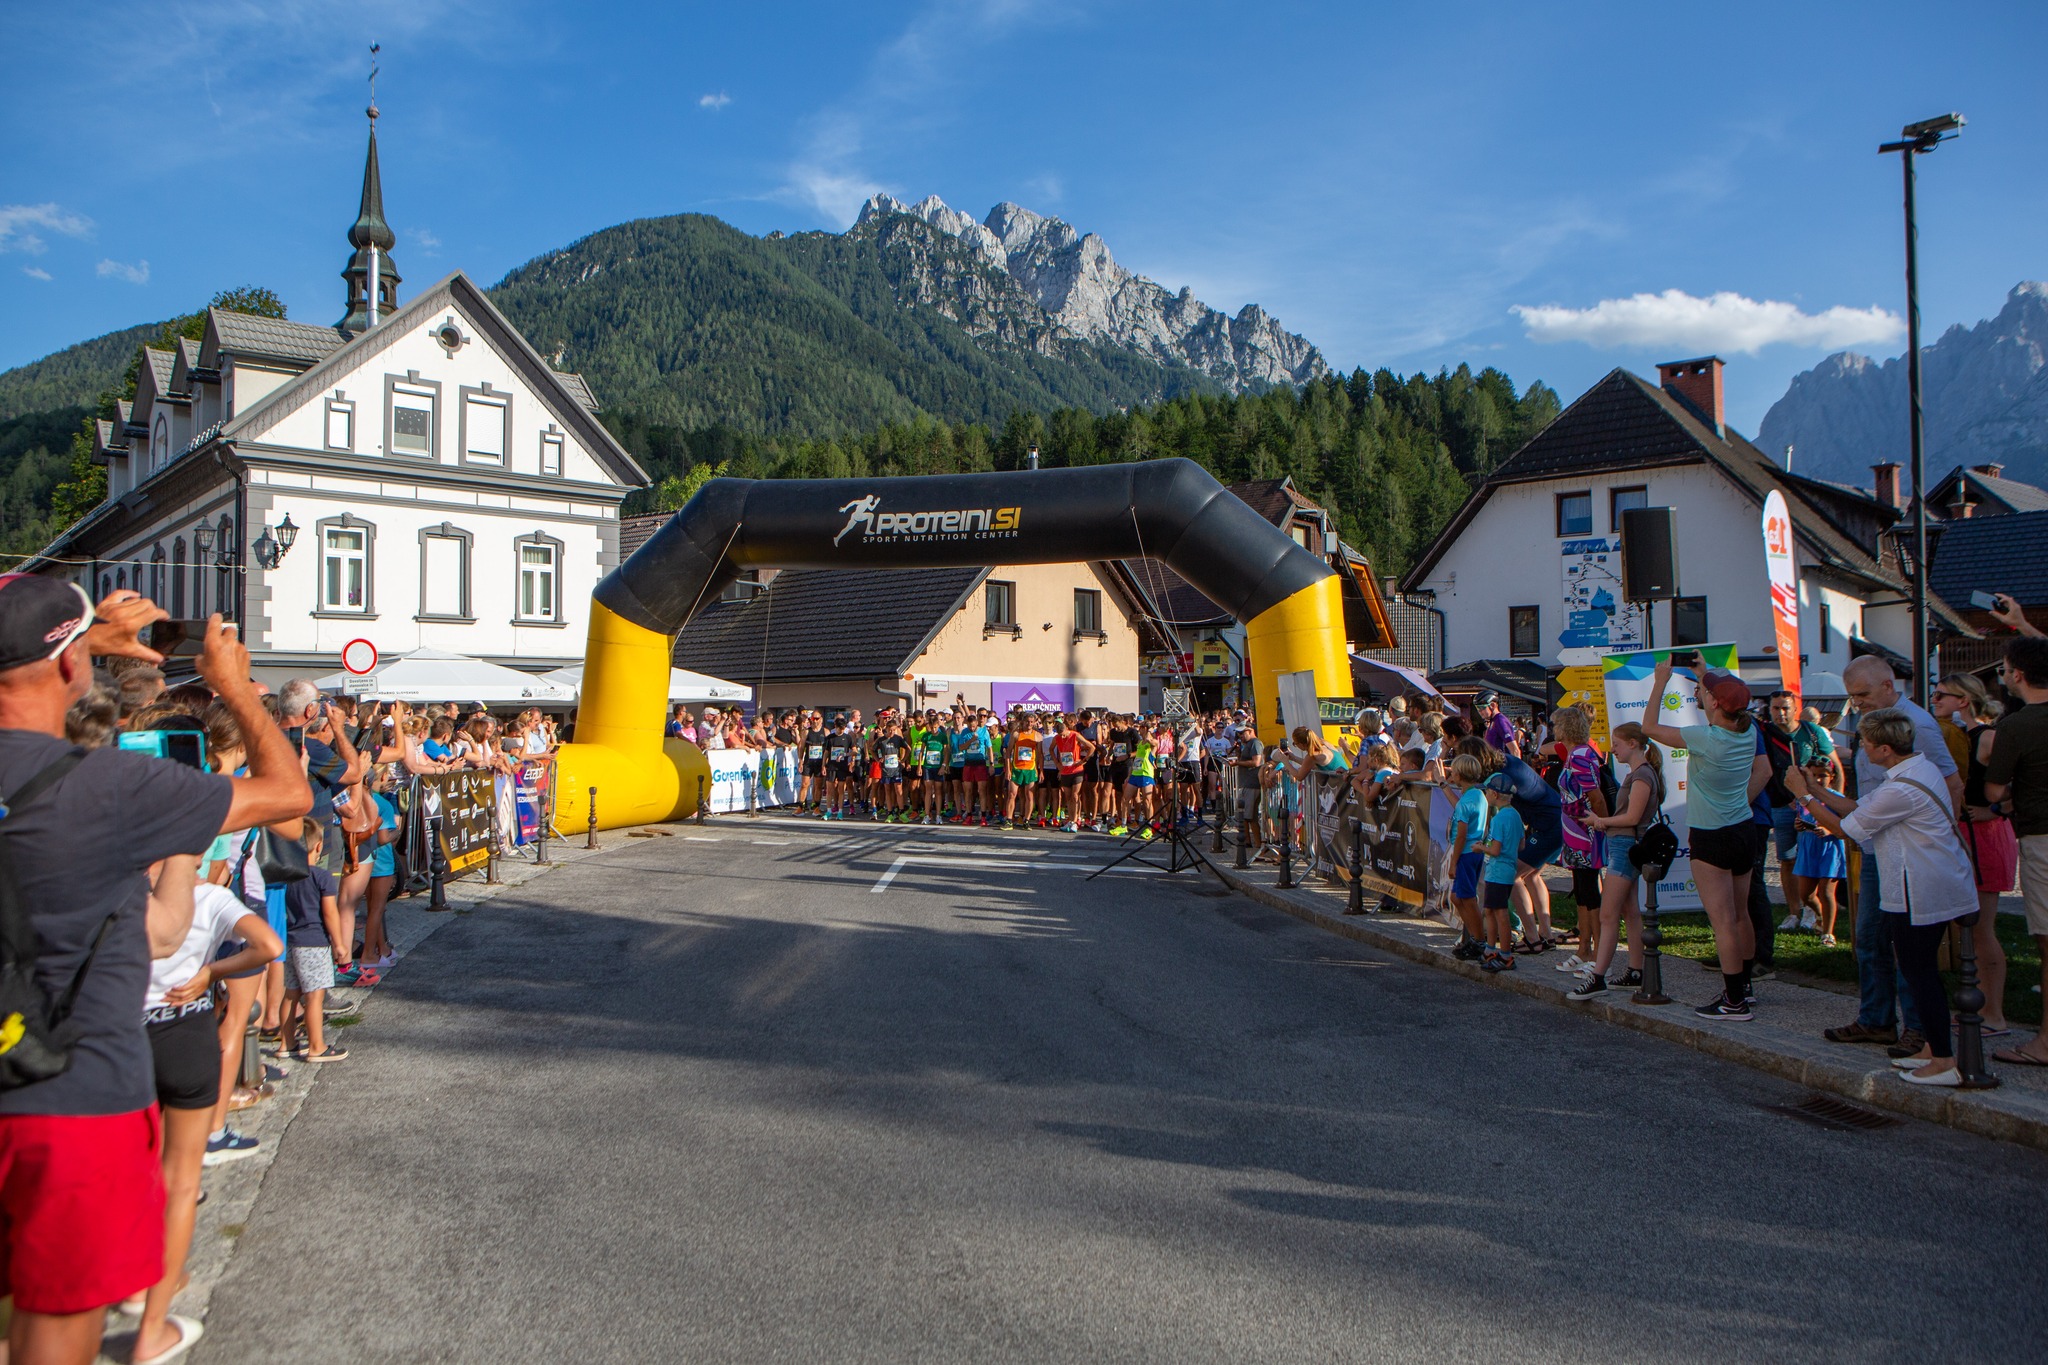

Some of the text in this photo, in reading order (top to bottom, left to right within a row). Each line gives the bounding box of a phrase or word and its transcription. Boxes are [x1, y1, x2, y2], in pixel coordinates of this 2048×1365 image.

[863, 530, 1018, 543] SPORT NUTRITION CENTER
[1008, 702, 1061, 711] NREMIČNINE
[1615, 700, 1649, 709] Gorenjs
[713, 768, 752, 783] Gorenjsk
